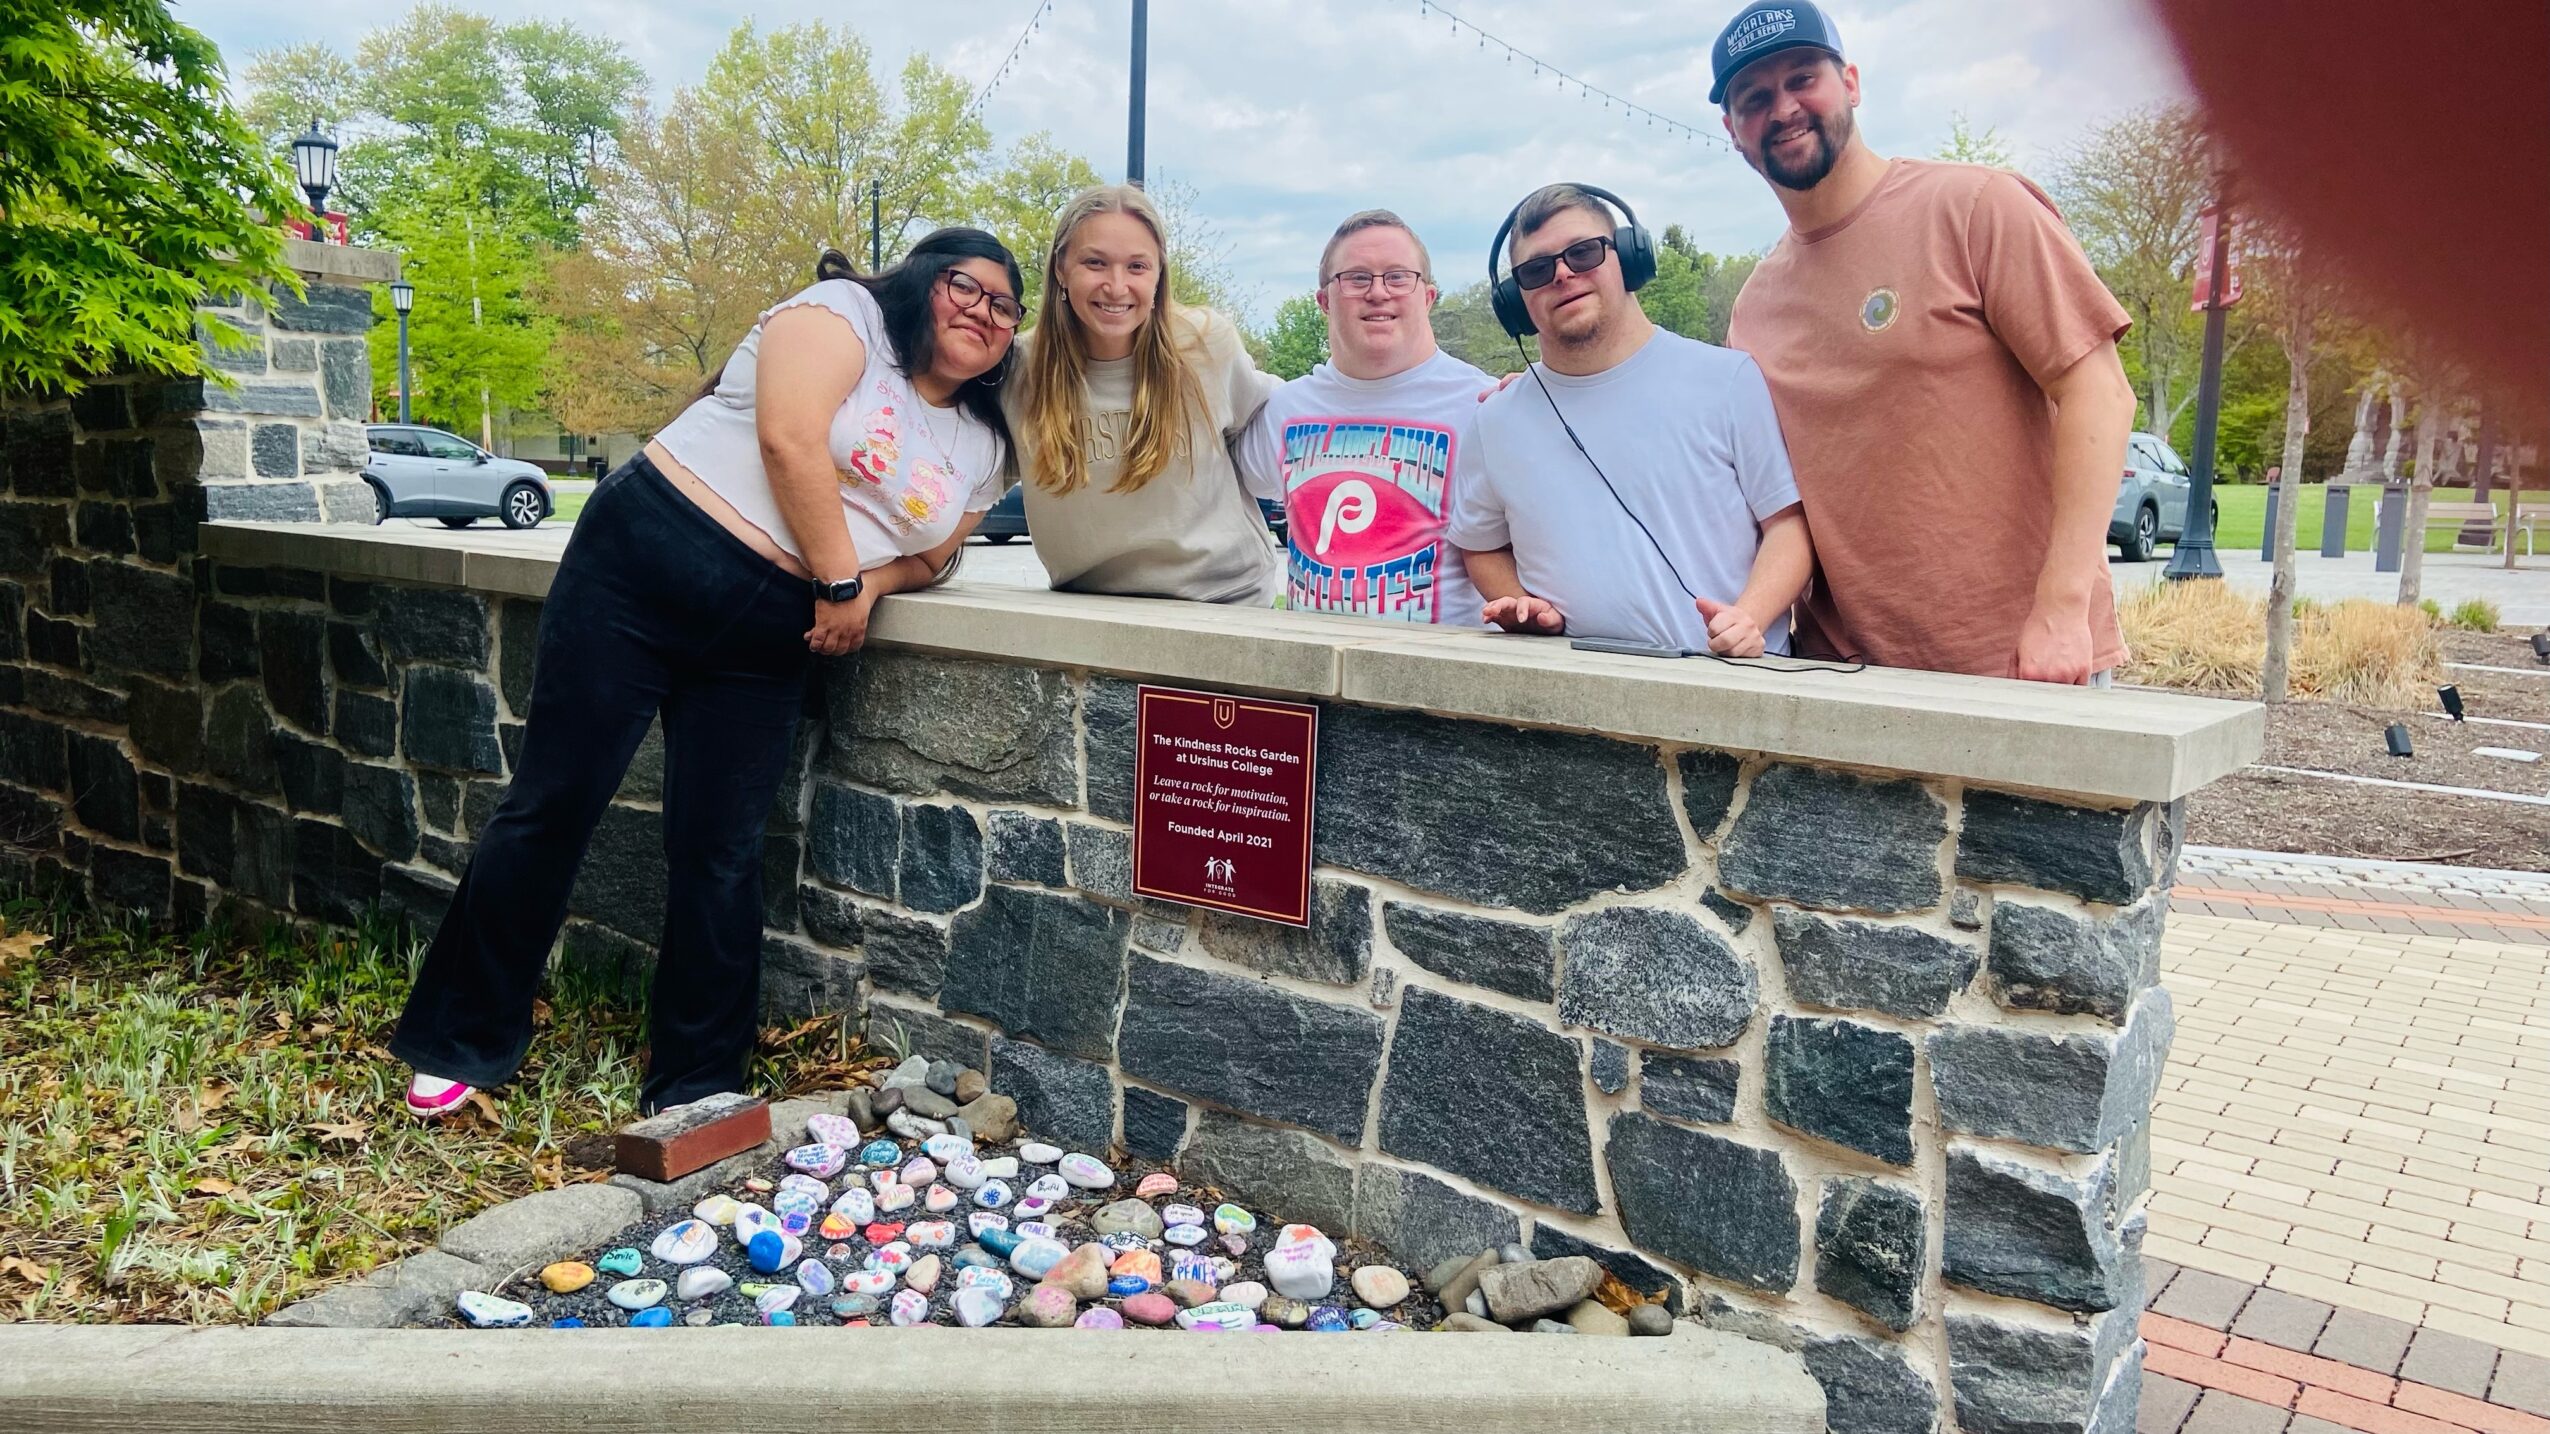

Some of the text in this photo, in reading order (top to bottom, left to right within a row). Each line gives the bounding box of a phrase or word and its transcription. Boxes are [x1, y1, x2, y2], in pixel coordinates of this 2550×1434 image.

[1153, 734, 1299, 764] The Kindness Rocks Garden
[1176, 753, 1273, 776] at Ursinus College
[1153, 774, 1289, 806] Leave a rock for motivation,
[1149, 792, 1291, 822] or take a rock for inspiration.
[1168, 821, 1272, 849] Founded April 2021
[1205, 882, 1234, 893] INTEGRATE
